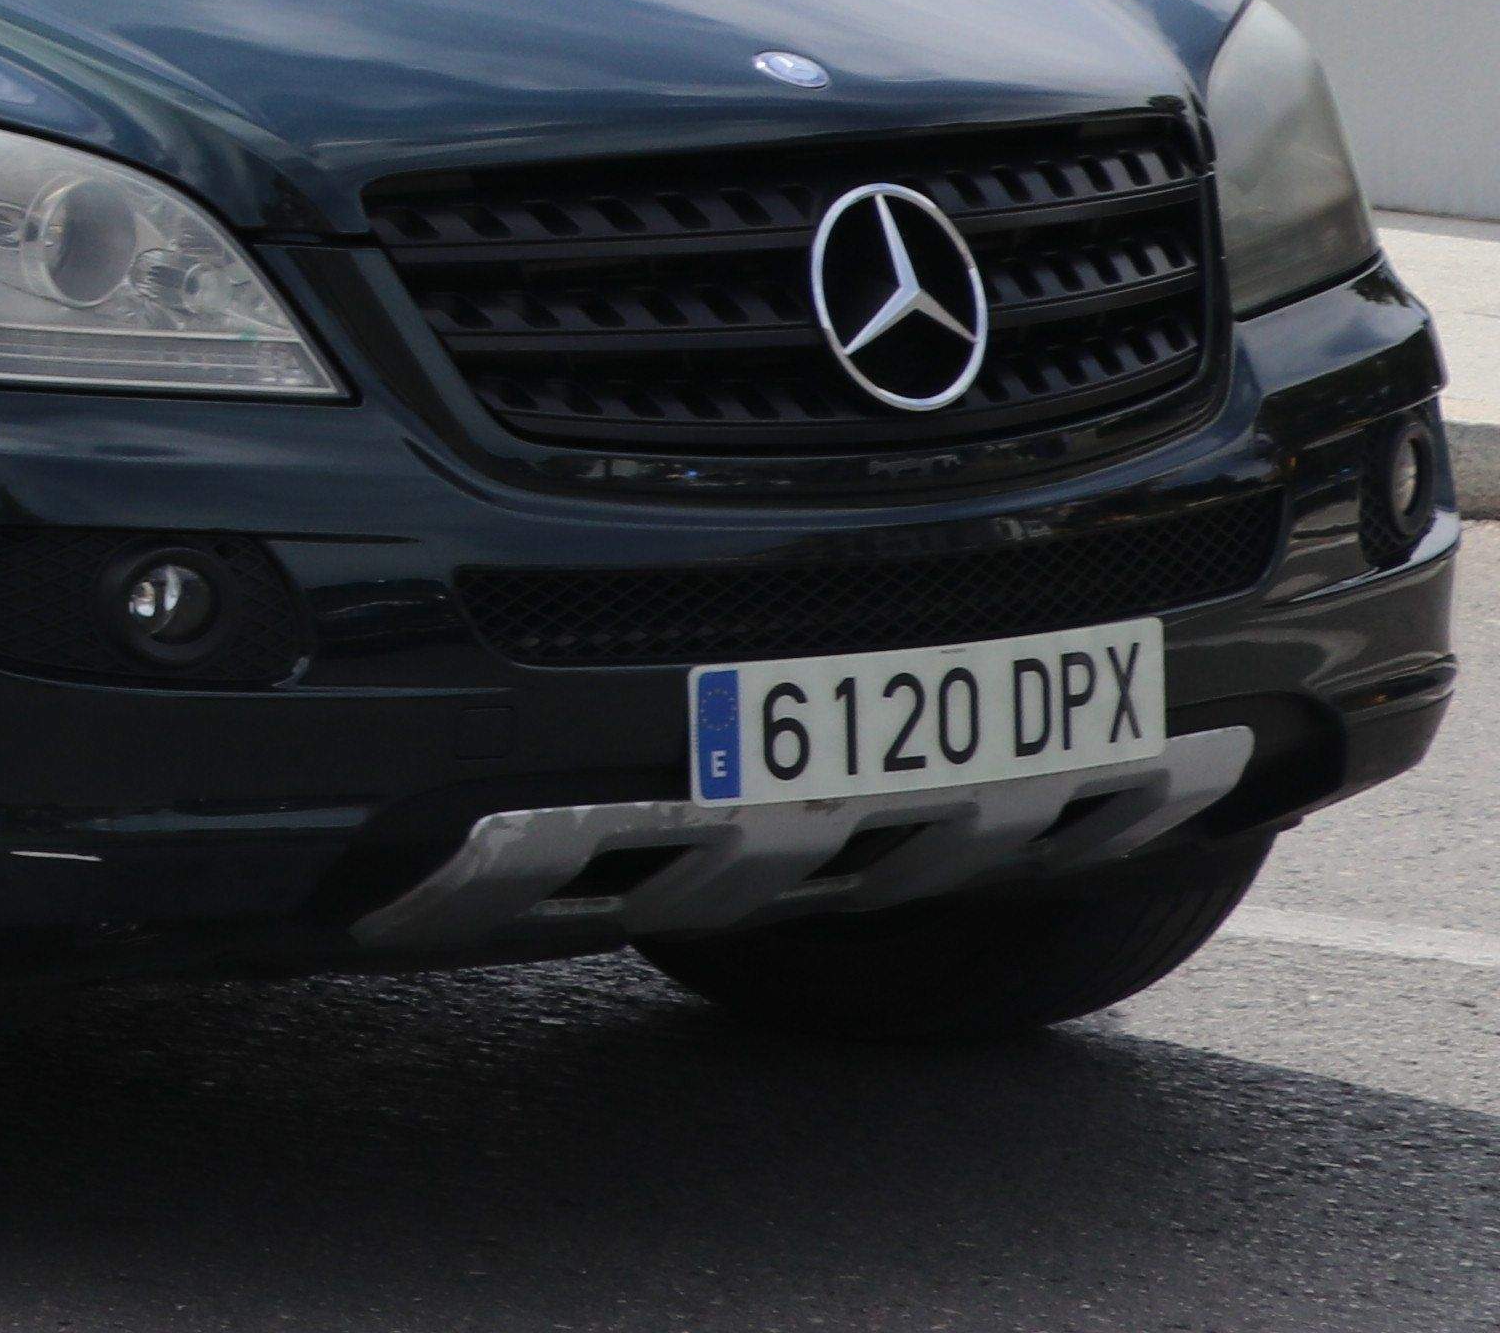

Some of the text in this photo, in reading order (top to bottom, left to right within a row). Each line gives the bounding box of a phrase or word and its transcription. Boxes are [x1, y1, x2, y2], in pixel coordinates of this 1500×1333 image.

[710, 641, 1143, 782] E 6120 DPX
